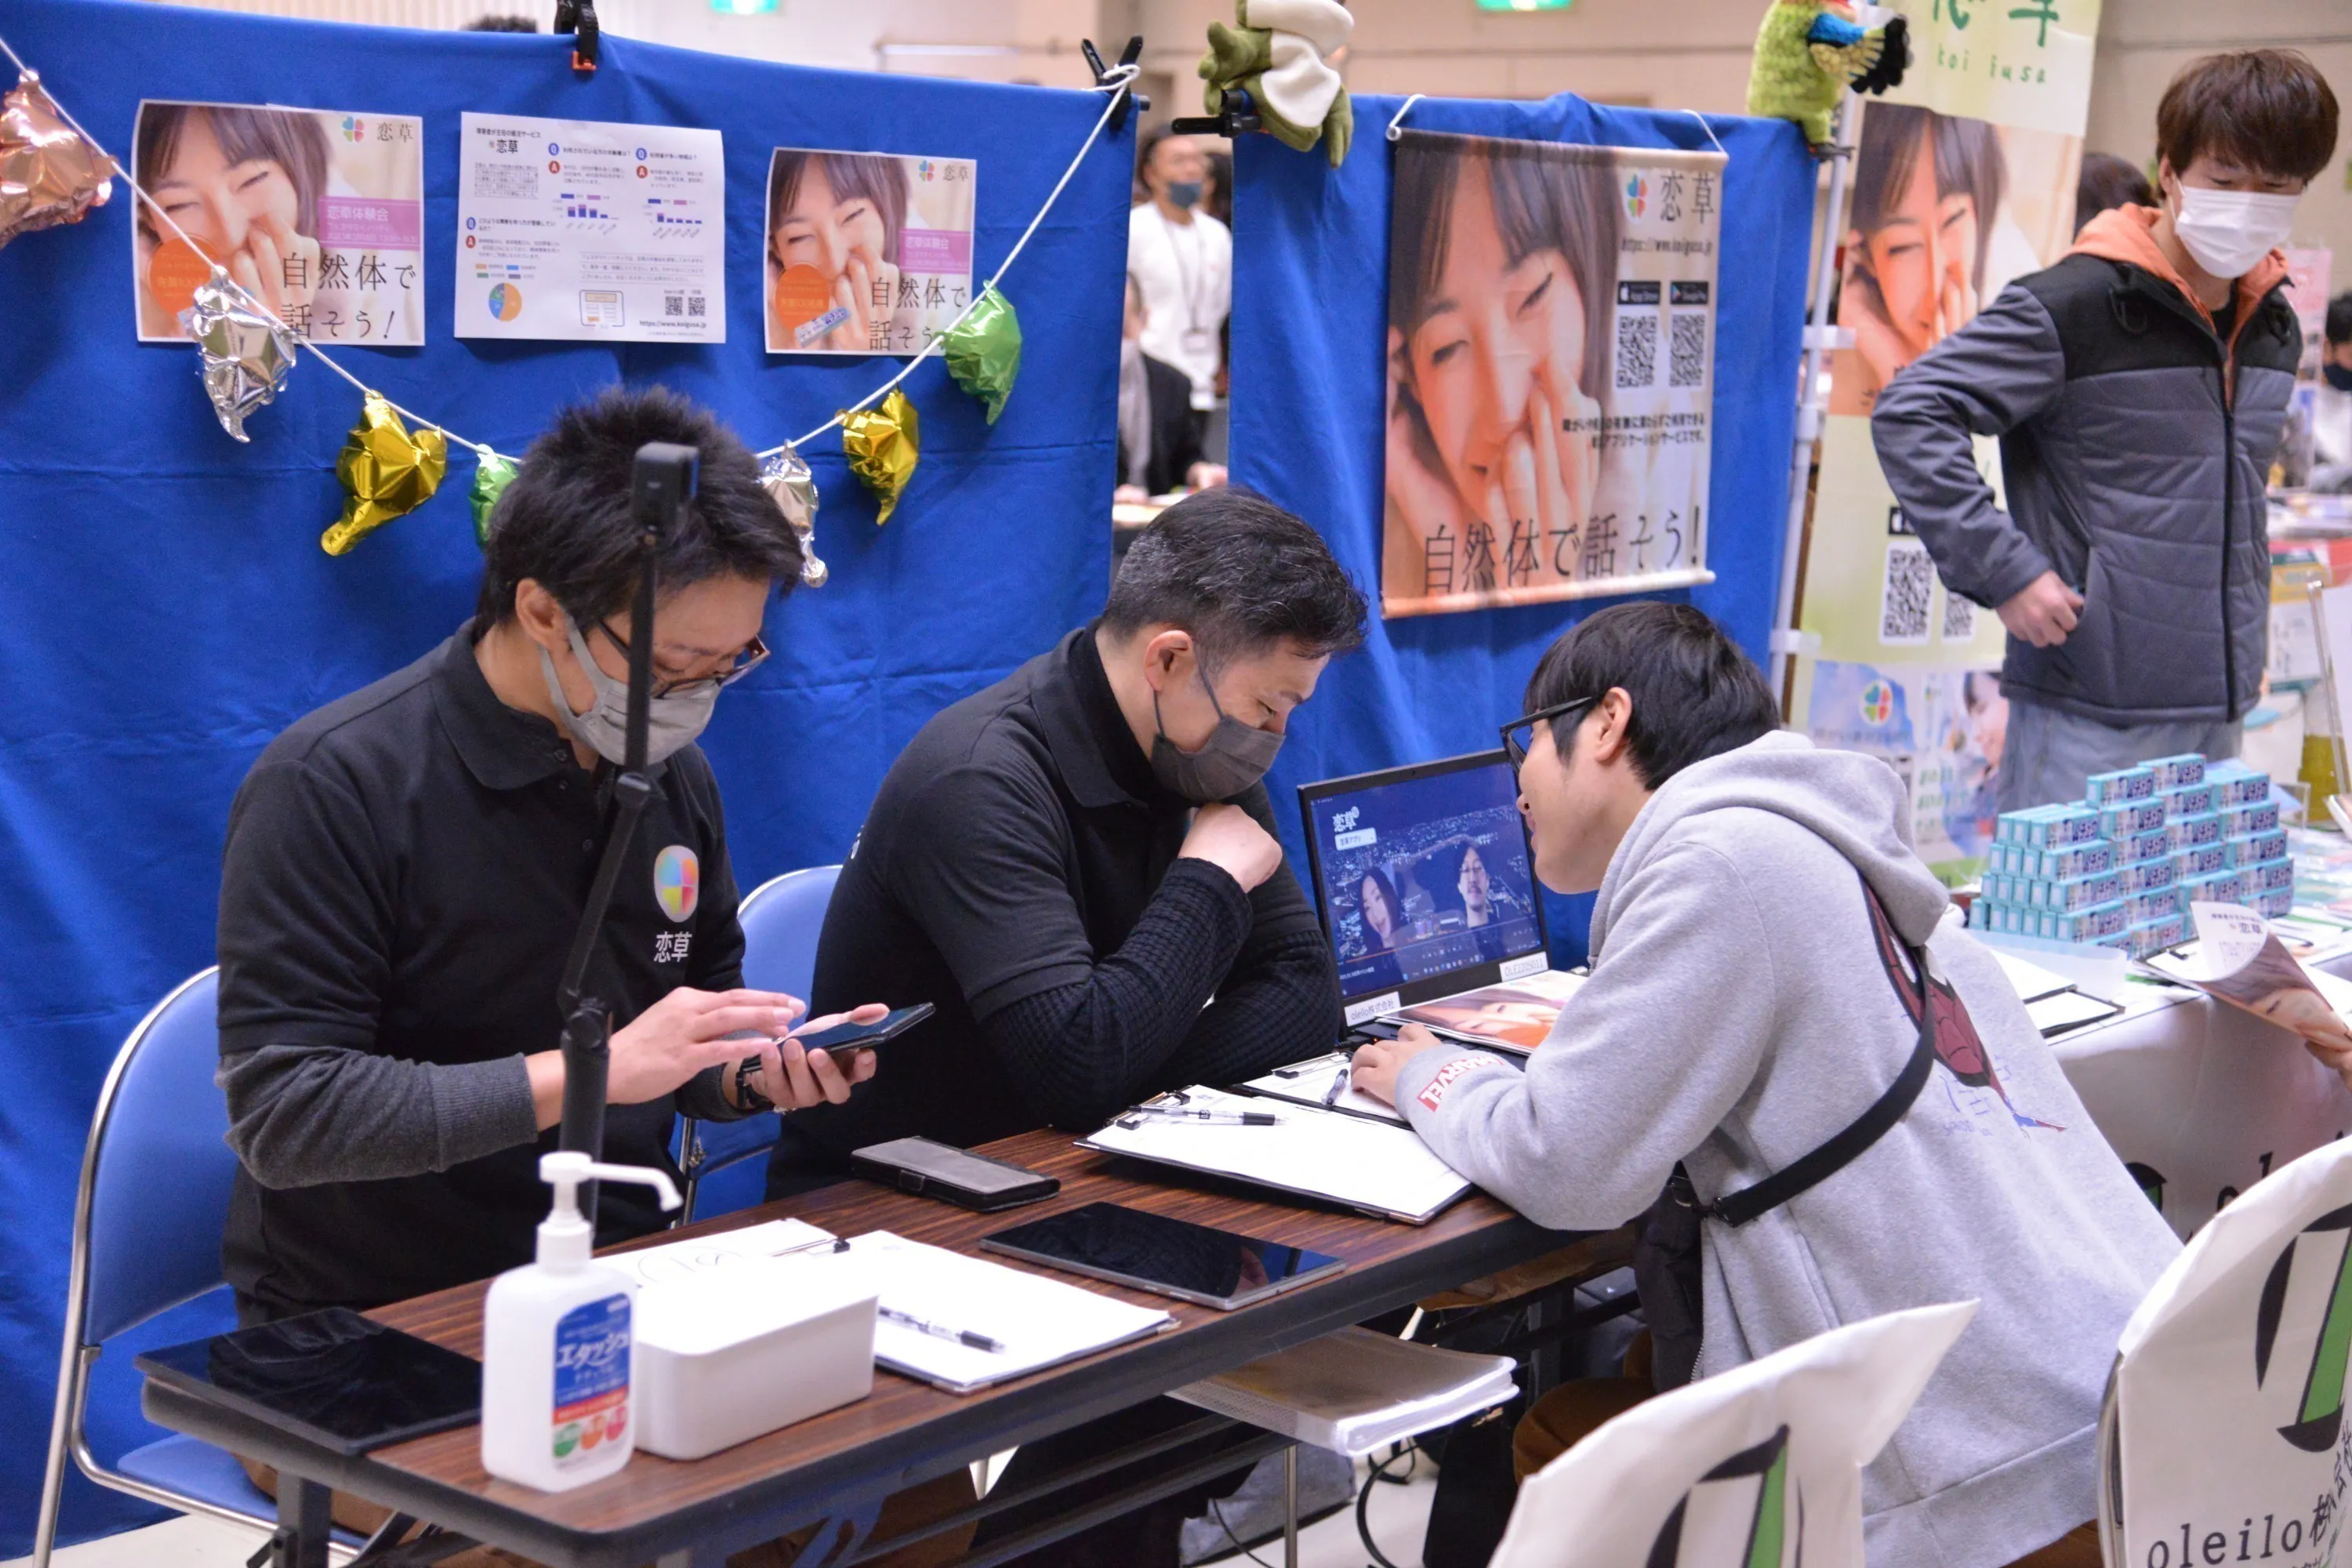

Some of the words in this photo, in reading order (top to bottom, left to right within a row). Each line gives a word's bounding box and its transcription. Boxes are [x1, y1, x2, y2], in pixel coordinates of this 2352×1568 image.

[376, 121, 413, 143] 恋草
[496, 139, 518, 154] 恋草
[942, 164, 970, 181] 恋草
[1659, 169, 1715, 224] 恋草
[283, 252, 416, 291] 自然体で
[870, 276, 967, 310] 自然体で
[280, 303, 395, 339] 話そう！
[1424, 506, 1700, 597] 自然体で話そう！
[653, 931, 692, 964] 恋草
